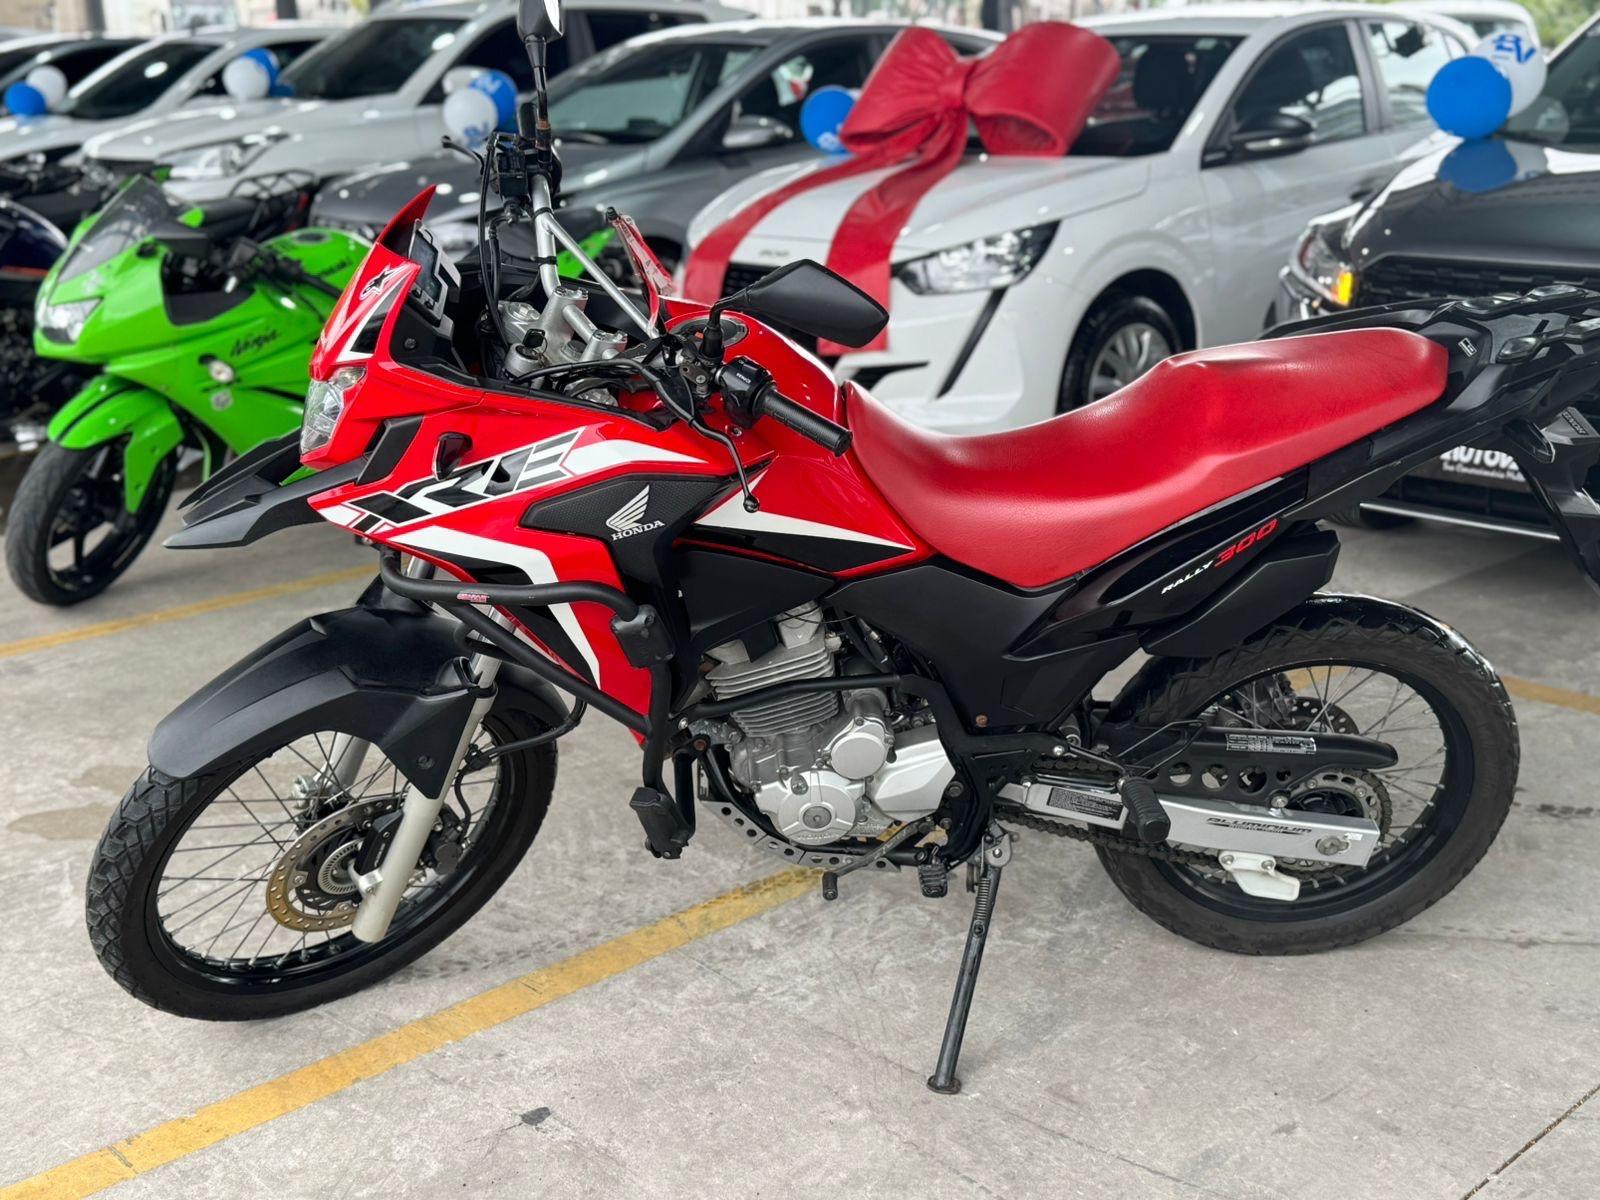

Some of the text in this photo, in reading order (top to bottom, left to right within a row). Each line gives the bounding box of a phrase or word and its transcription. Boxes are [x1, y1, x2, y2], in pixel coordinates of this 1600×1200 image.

[611, 520, 666, 541] HONDA
[1160, 518, 1278, 595] RALLY 300
[1206, 817, 1313, 834] ALUMINIUM
